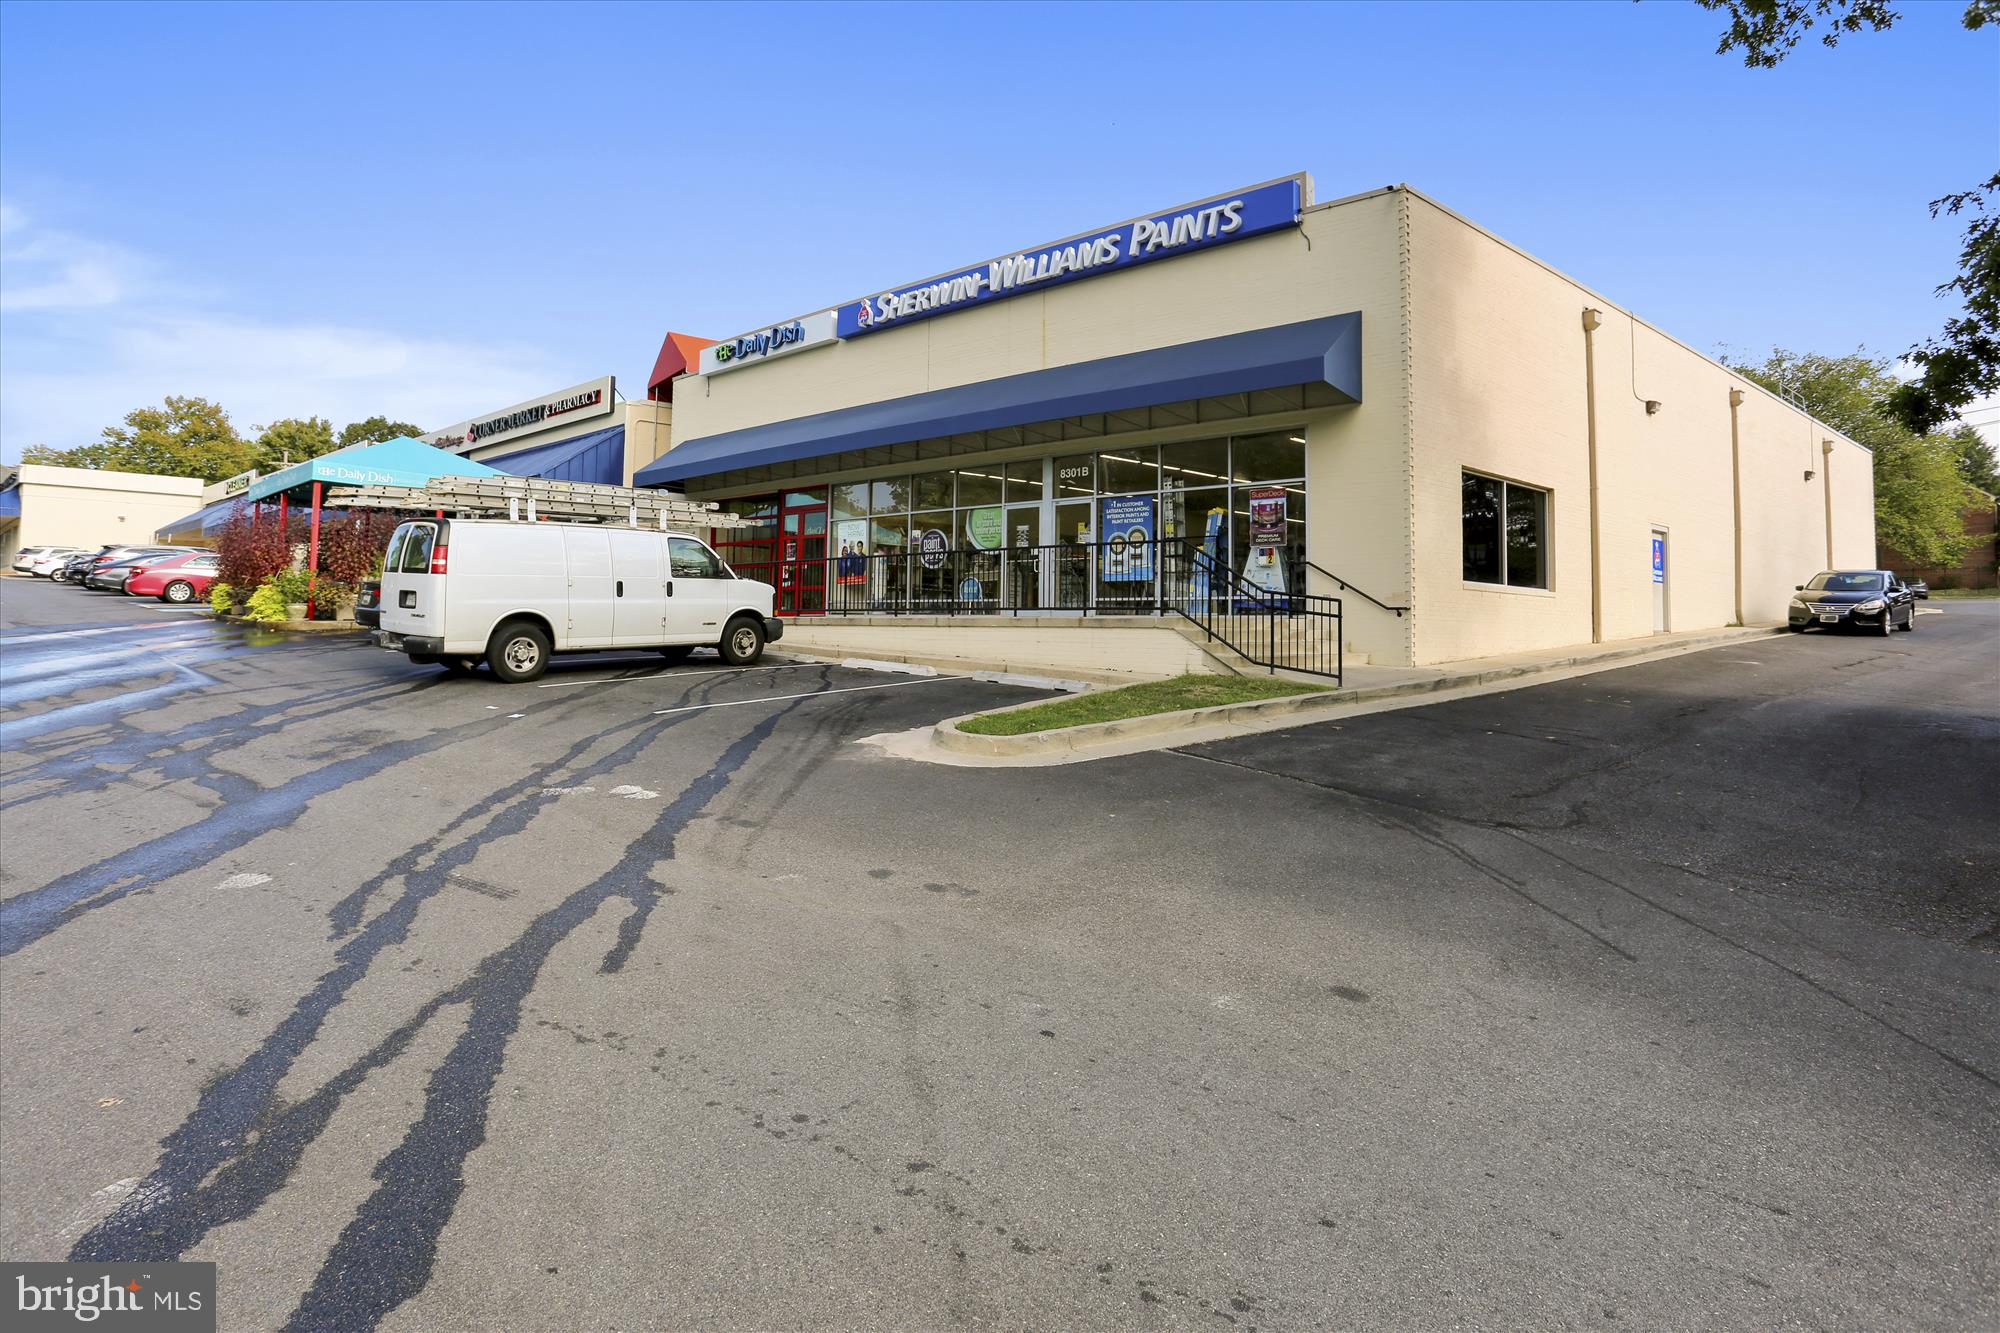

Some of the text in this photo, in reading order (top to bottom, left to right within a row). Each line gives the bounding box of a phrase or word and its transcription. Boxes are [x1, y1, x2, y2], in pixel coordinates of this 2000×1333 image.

[874, 200, 1244, 324] SHERWIN-WILLIAMS PAINTS
[735, 333, 771, 359] Daily
[770, 320, 805, 349] Dish
[474, 415, 508, 439] CORNER
[507, 404, 546, 430] MARKET
[551, 390, 598, 414] PHARMACY
[337, 469, 365, 482] Daily
[368, 470, 393, 483] Dish
[1060, 466, 1089, 479] 8301B
[1251, 489, 1285, 498] SuperDeck
[924, 536, 940, 551] paint
